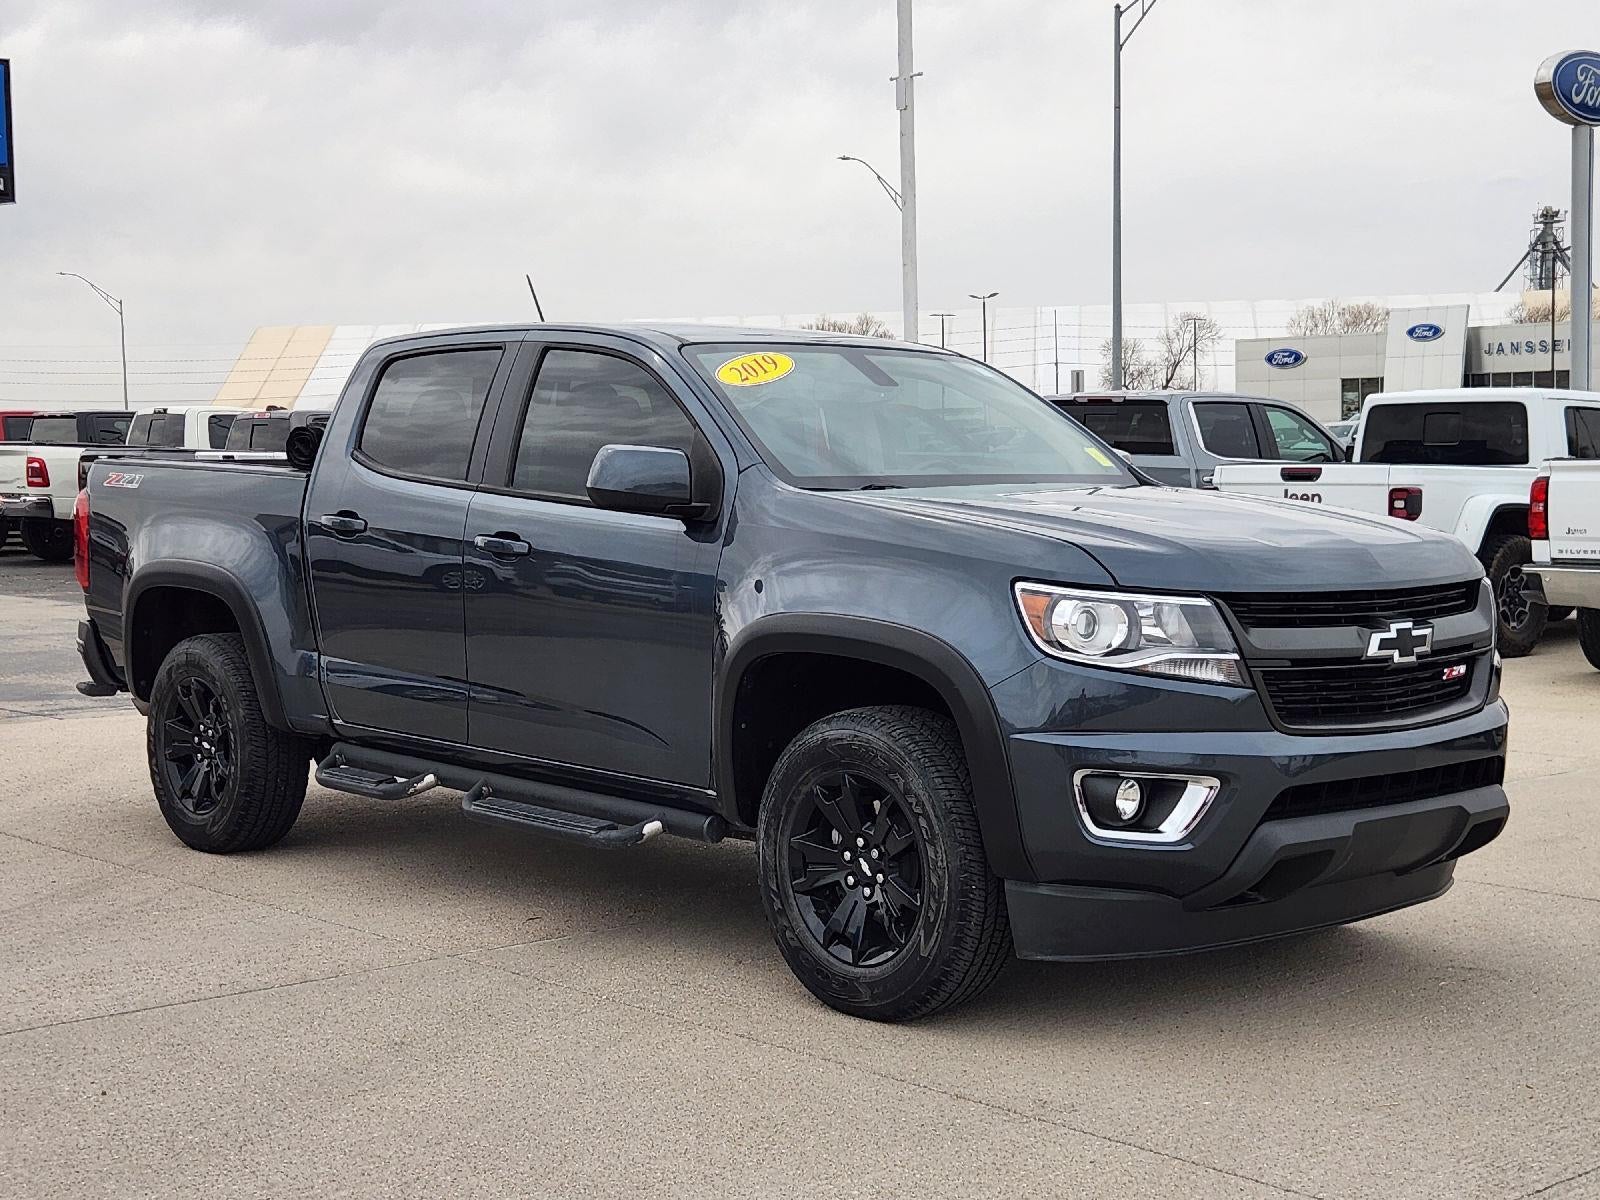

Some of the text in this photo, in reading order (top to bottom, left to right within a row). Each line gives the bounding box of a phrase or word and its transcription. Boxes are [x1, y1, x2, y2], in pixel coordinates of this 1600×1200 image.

[1572, 64, 1600, 106] Fo
[1413, 327, 1435, 338] Ford
[1272, 352, 1295, 365] Ford
[729, 354, 778, 382] 2019
[103, 472, 144, 488] Z71
